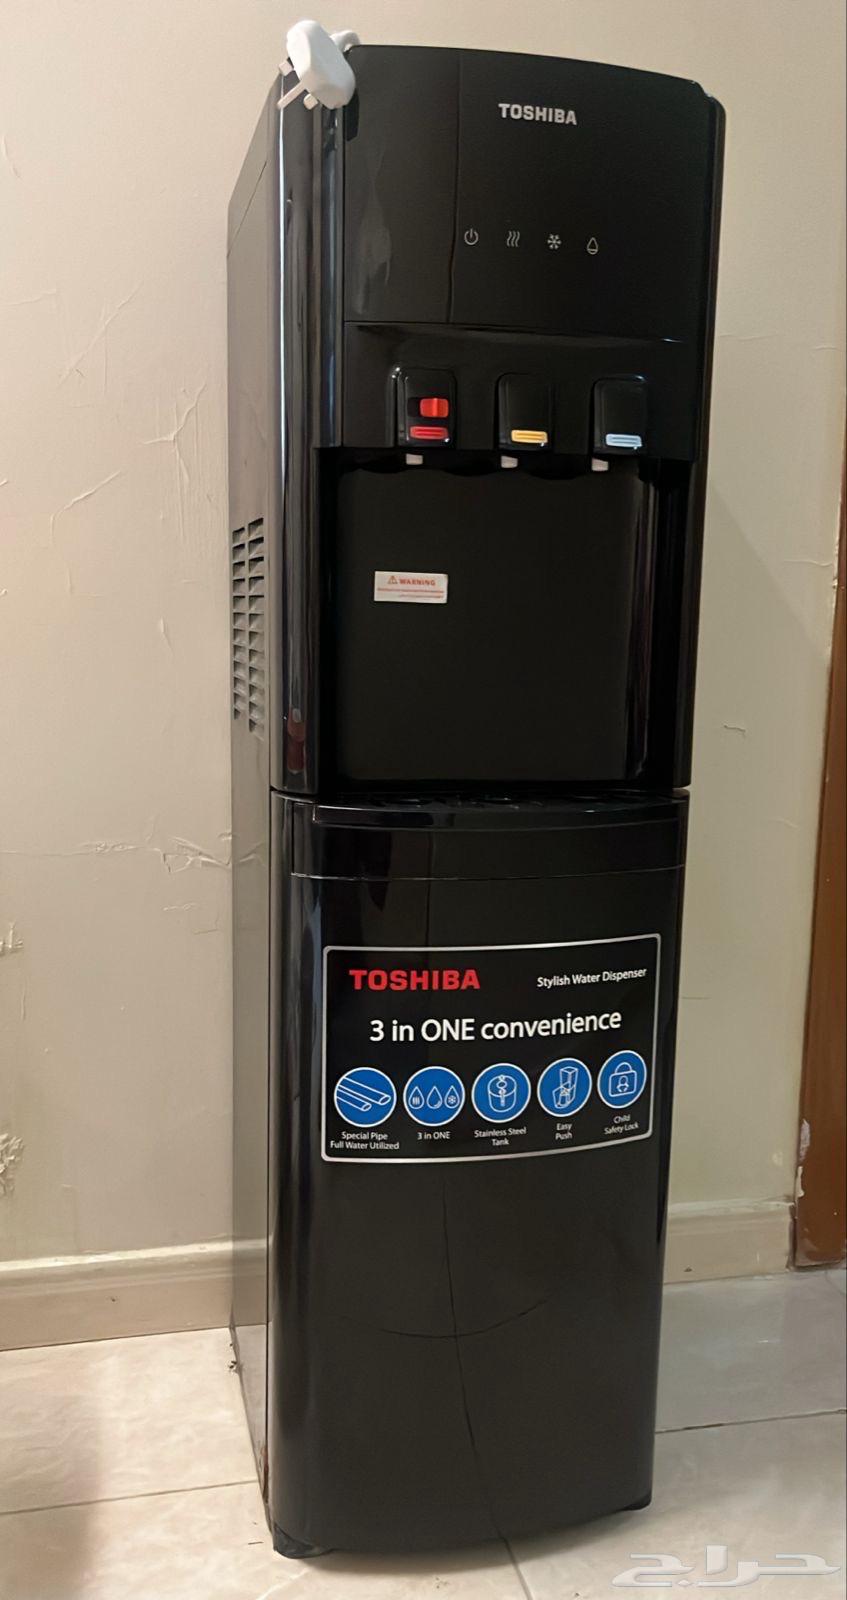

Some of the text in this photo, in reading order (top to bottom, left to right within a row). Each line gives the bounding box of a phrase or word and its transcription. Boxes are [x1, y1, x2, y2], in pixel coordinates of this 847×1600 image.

[498, 103, 577, 125] TOSHIBA
[349, 968, 480, 991] TOSHIBA
[537, 967, 647, 989] Stylish Water Dispenser
[369, 1012, 623, 1042] 3 in ONE convenience
[613, 1114, 631, 1124] Child
[474, 1127, 527, 1138] Stainless Steel
[556, 1123, 572, 1132] Easy
[603, 1122, 639, 1135] Safety Lock
[342, 1131, 388, 1141] Special Pipe
[417, 1131, 451, 1140] 3 in ONE
[555, 1132, 573, 1140] Push
[330, 1140, 400, 1150] Full Water Utilized
[491, 1138, 510, 1146] Tank
